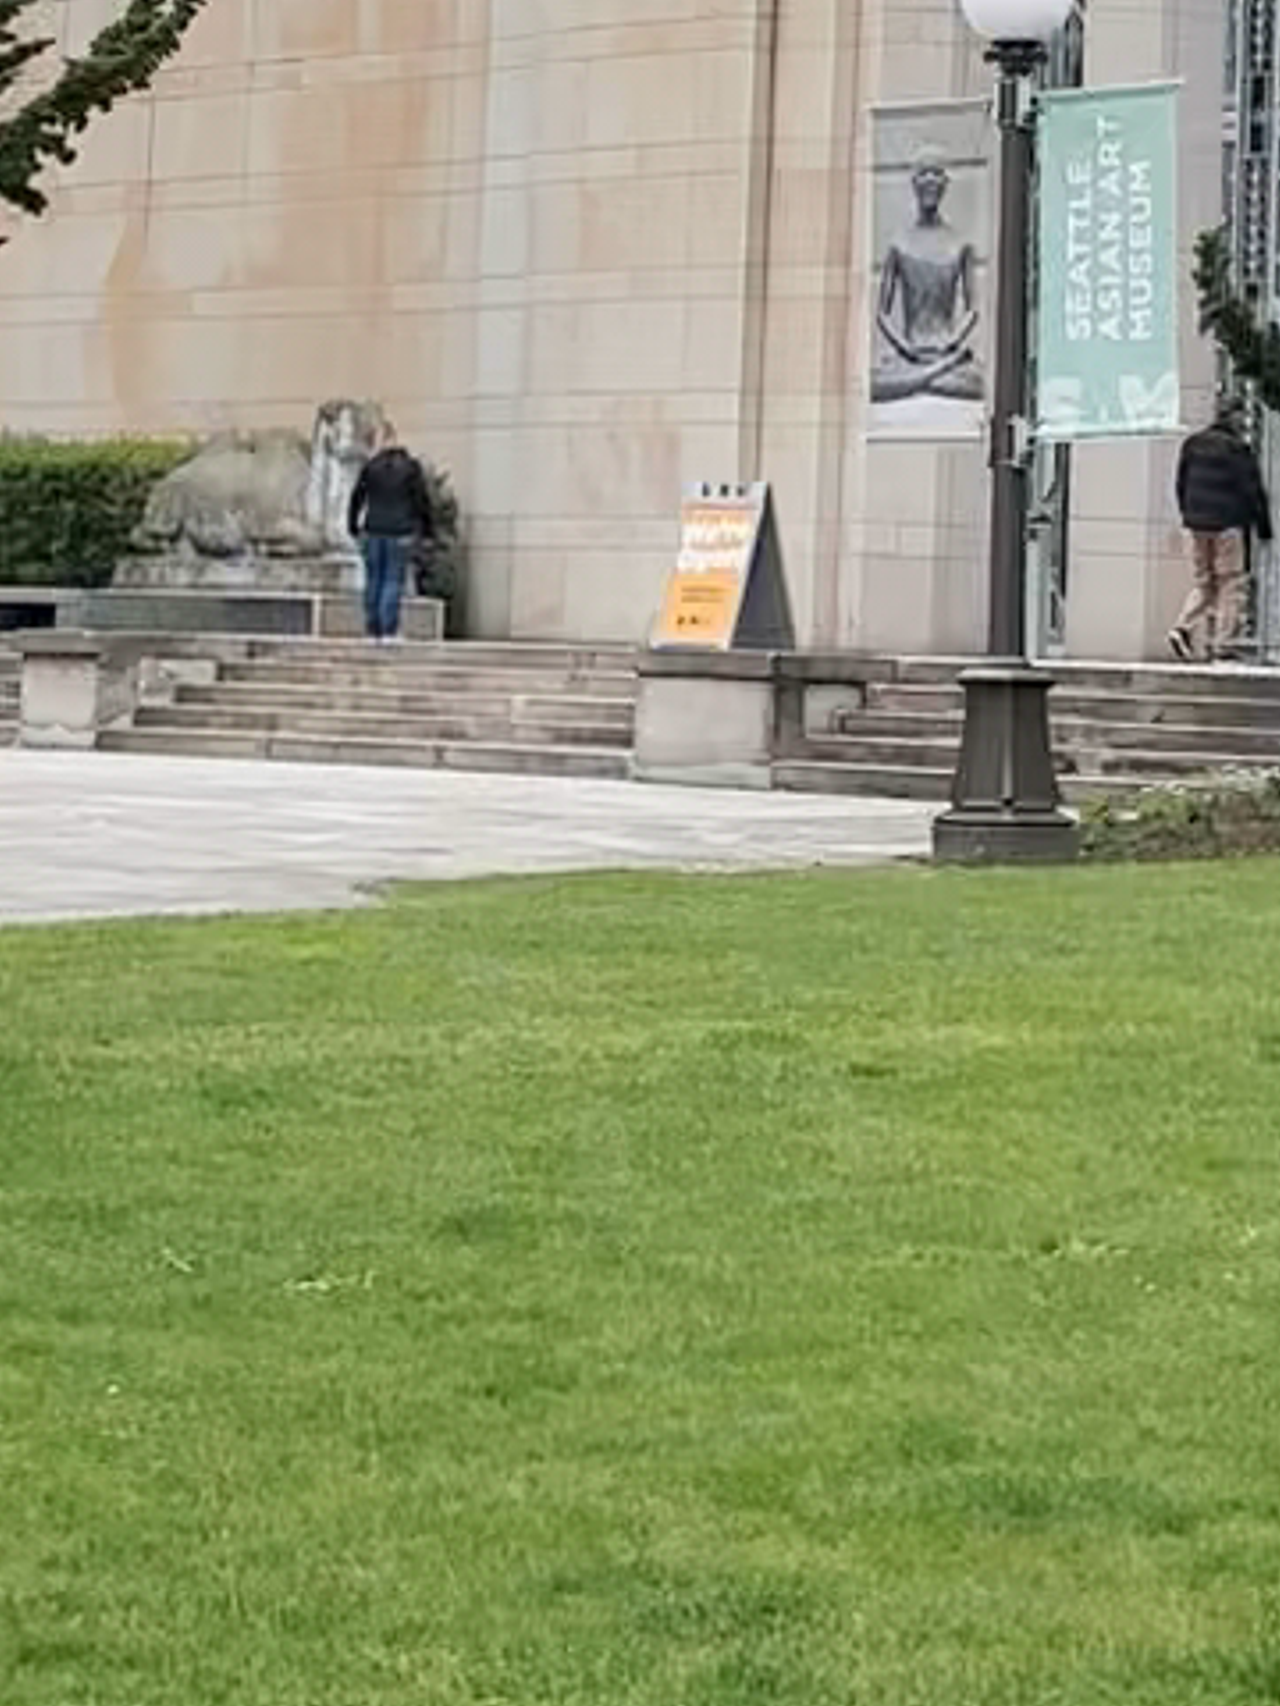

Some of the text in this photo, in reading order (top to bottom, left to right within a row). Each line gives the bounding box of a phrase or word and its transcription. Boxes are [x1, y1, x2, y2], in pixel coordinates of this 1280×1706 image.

[1066, 159, 1092, 340] SEATTLE
[1097, 116, 1122, 340] ASIAN ART
[1129, 160, 1152, 340] MUSEUM
